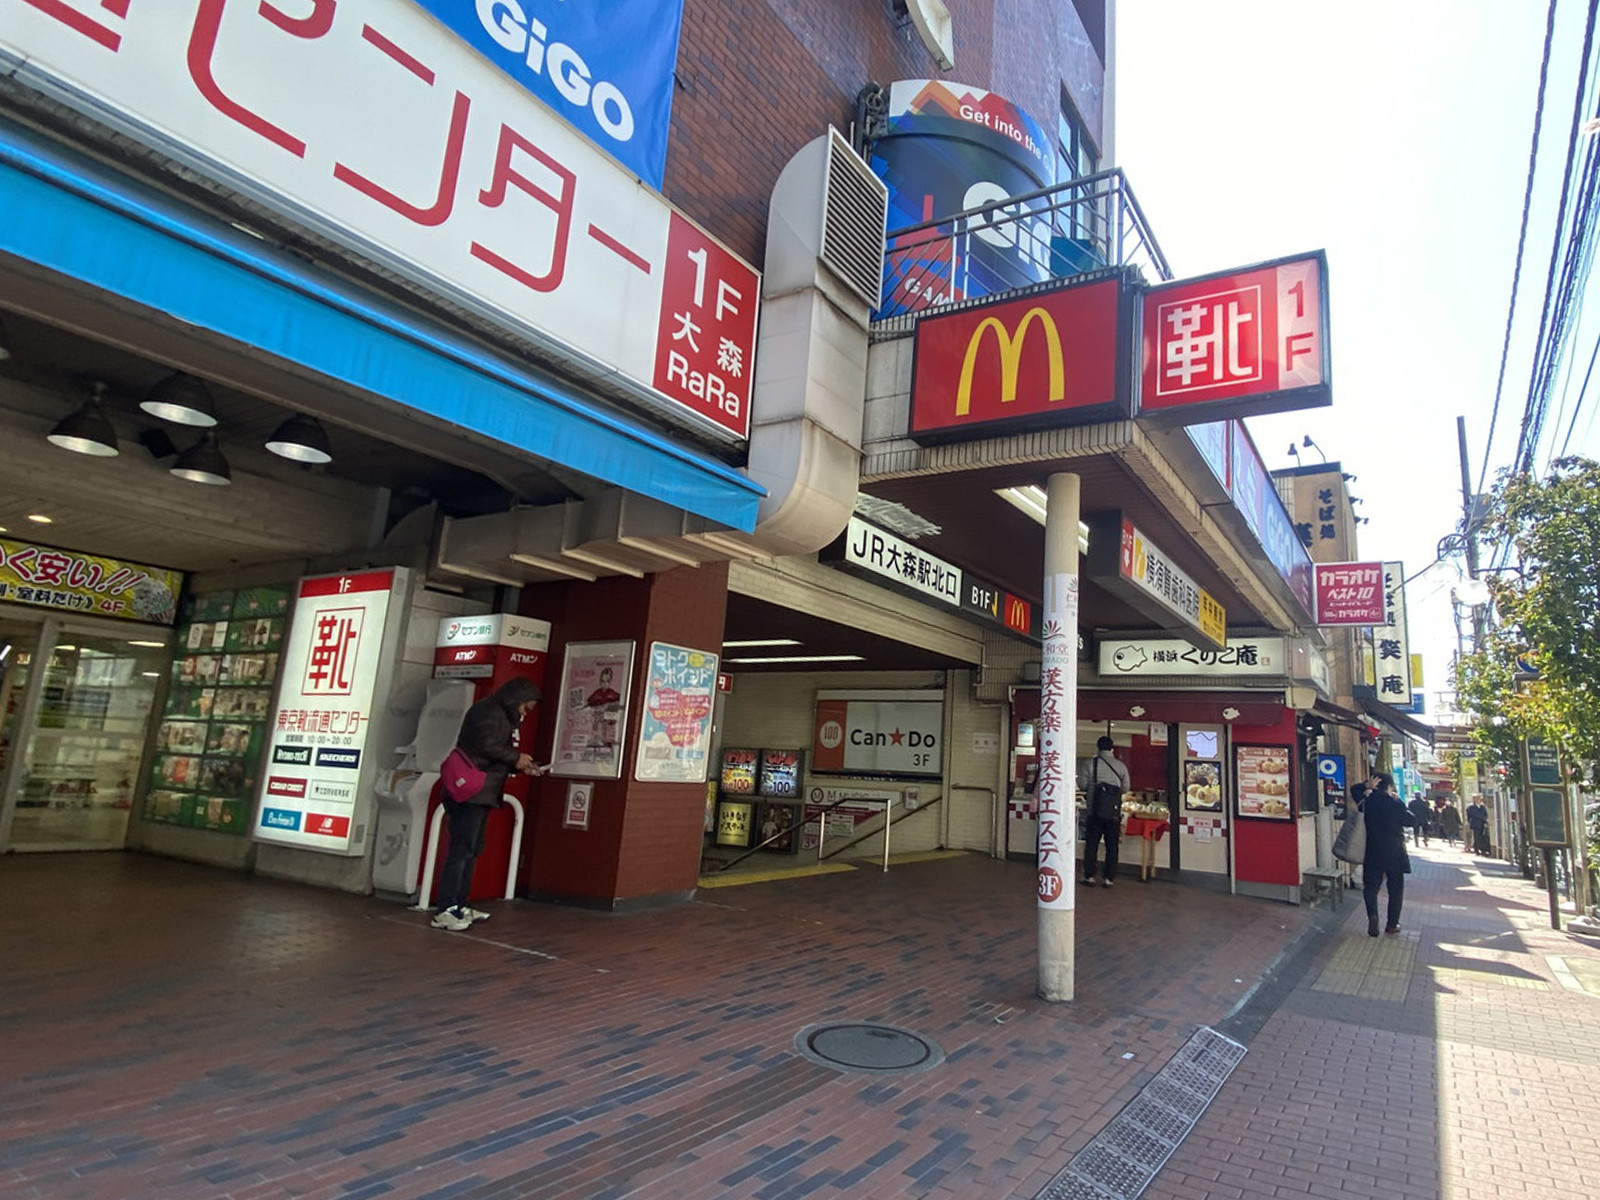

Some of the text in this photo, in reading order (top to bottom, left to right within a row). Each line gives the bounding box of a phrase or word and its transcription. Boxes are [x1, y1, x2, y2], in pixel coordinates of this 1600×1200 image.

[474, 0, 634, 142] GiGO
[959, 104, 1042, 159] Get into the
[687, 247, 742, 322] 1F
[672, 311, 742, 379] 大森
[666, 350, 740, 418] RaRa
[0, 544, 149, 596] く安い!!
[853, 529, 957, 599] JR大森駅北口
[338, 577, 352, 593] 1F
[1321, 569, 1380, 586] カラオケ
[971, 585, 991, 610] B1F
[1327, 587, 1375, 600] ベスト10
[100, 600, 125, 612] 4F
[461, 624, 492, 636] セブン銀行
[308, 615, 357, 689] 靴
[510, 652, 531, 664] ATM
[1152, 649, 1179, 663] 横浜
[277, 710, 369, 734] 東京靴流通センター
[823, 726, 936, 748] 100 Can Do
[912, 753, 931, 767] 3F
[319, 787, 350, 798] CONVERSE
[733, 779, 749, 790] 100
[773, 781, 791, 793] 100
[1038, 873, 1059, 897] 3F
